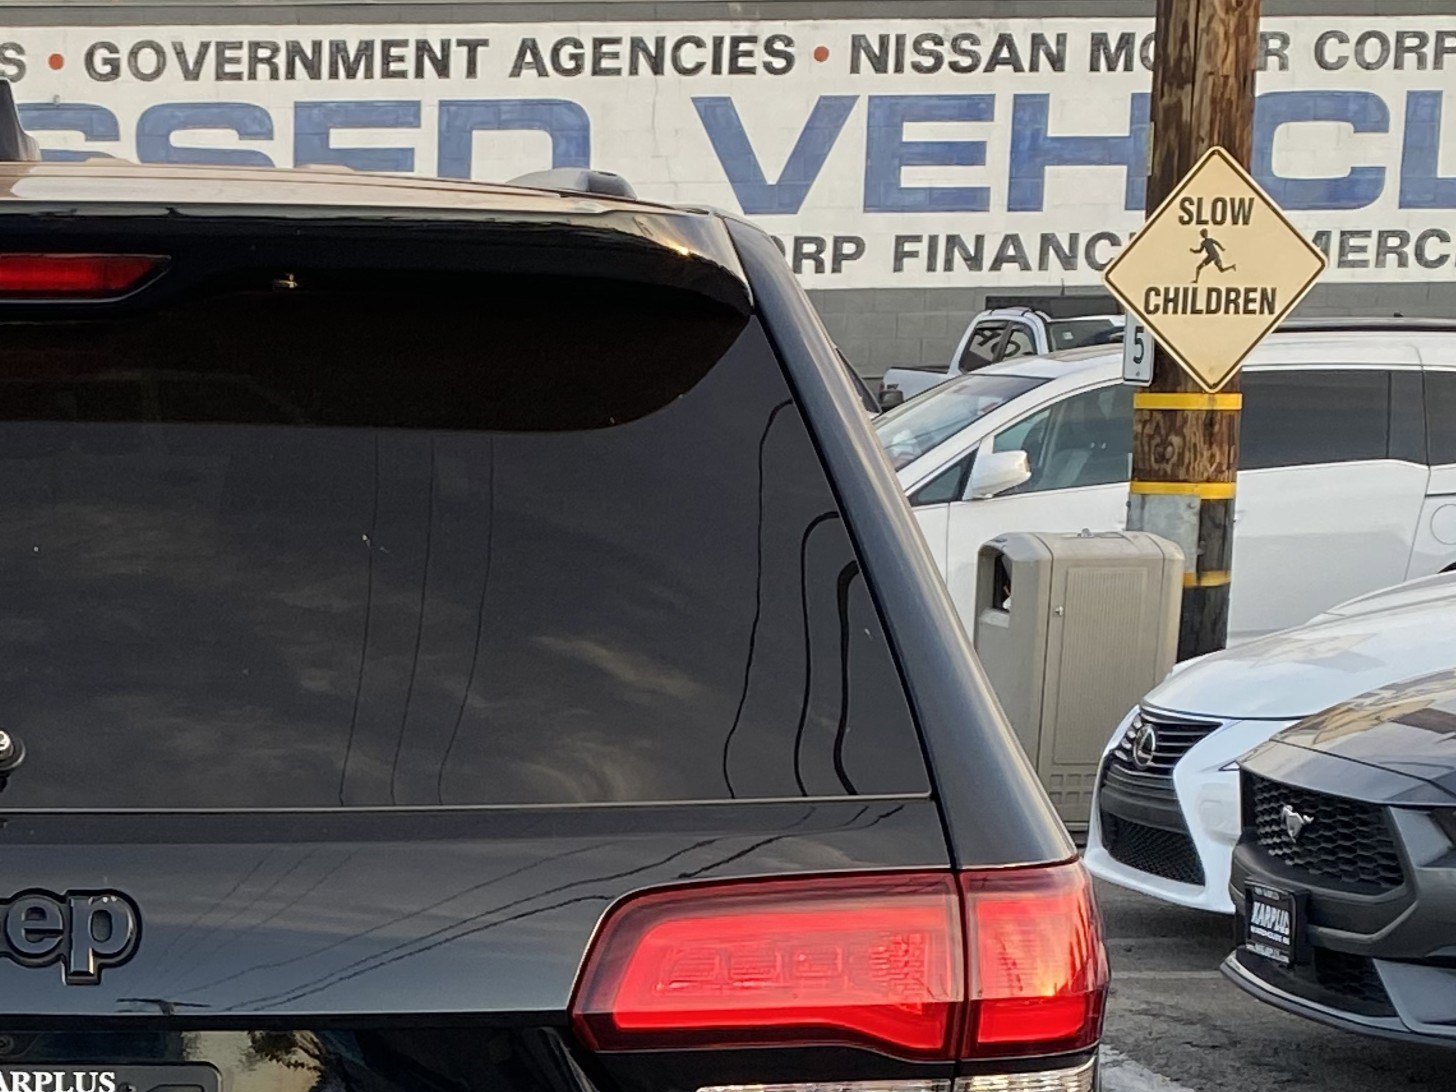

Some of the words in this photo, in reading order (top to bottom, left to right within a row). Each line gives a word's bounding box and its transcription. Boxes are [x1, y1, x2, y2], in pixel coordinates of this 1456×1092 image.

[84, 38, 490, 82] GOVERNMENT
[508, 35, 795, 78] AGENCIES
[849, 32, 1068, 75] NISSAN
[691, 91, 1456, 214] VEHCL
[1178, 196, 1255, 226] SLOW
[892, 232, 1136, 273] FINANC
[1311, 228, 1456, 270] ERC
[1144, 286, 1278, 317] CHILDREN
[1132, 325, 1145, 365] 5
